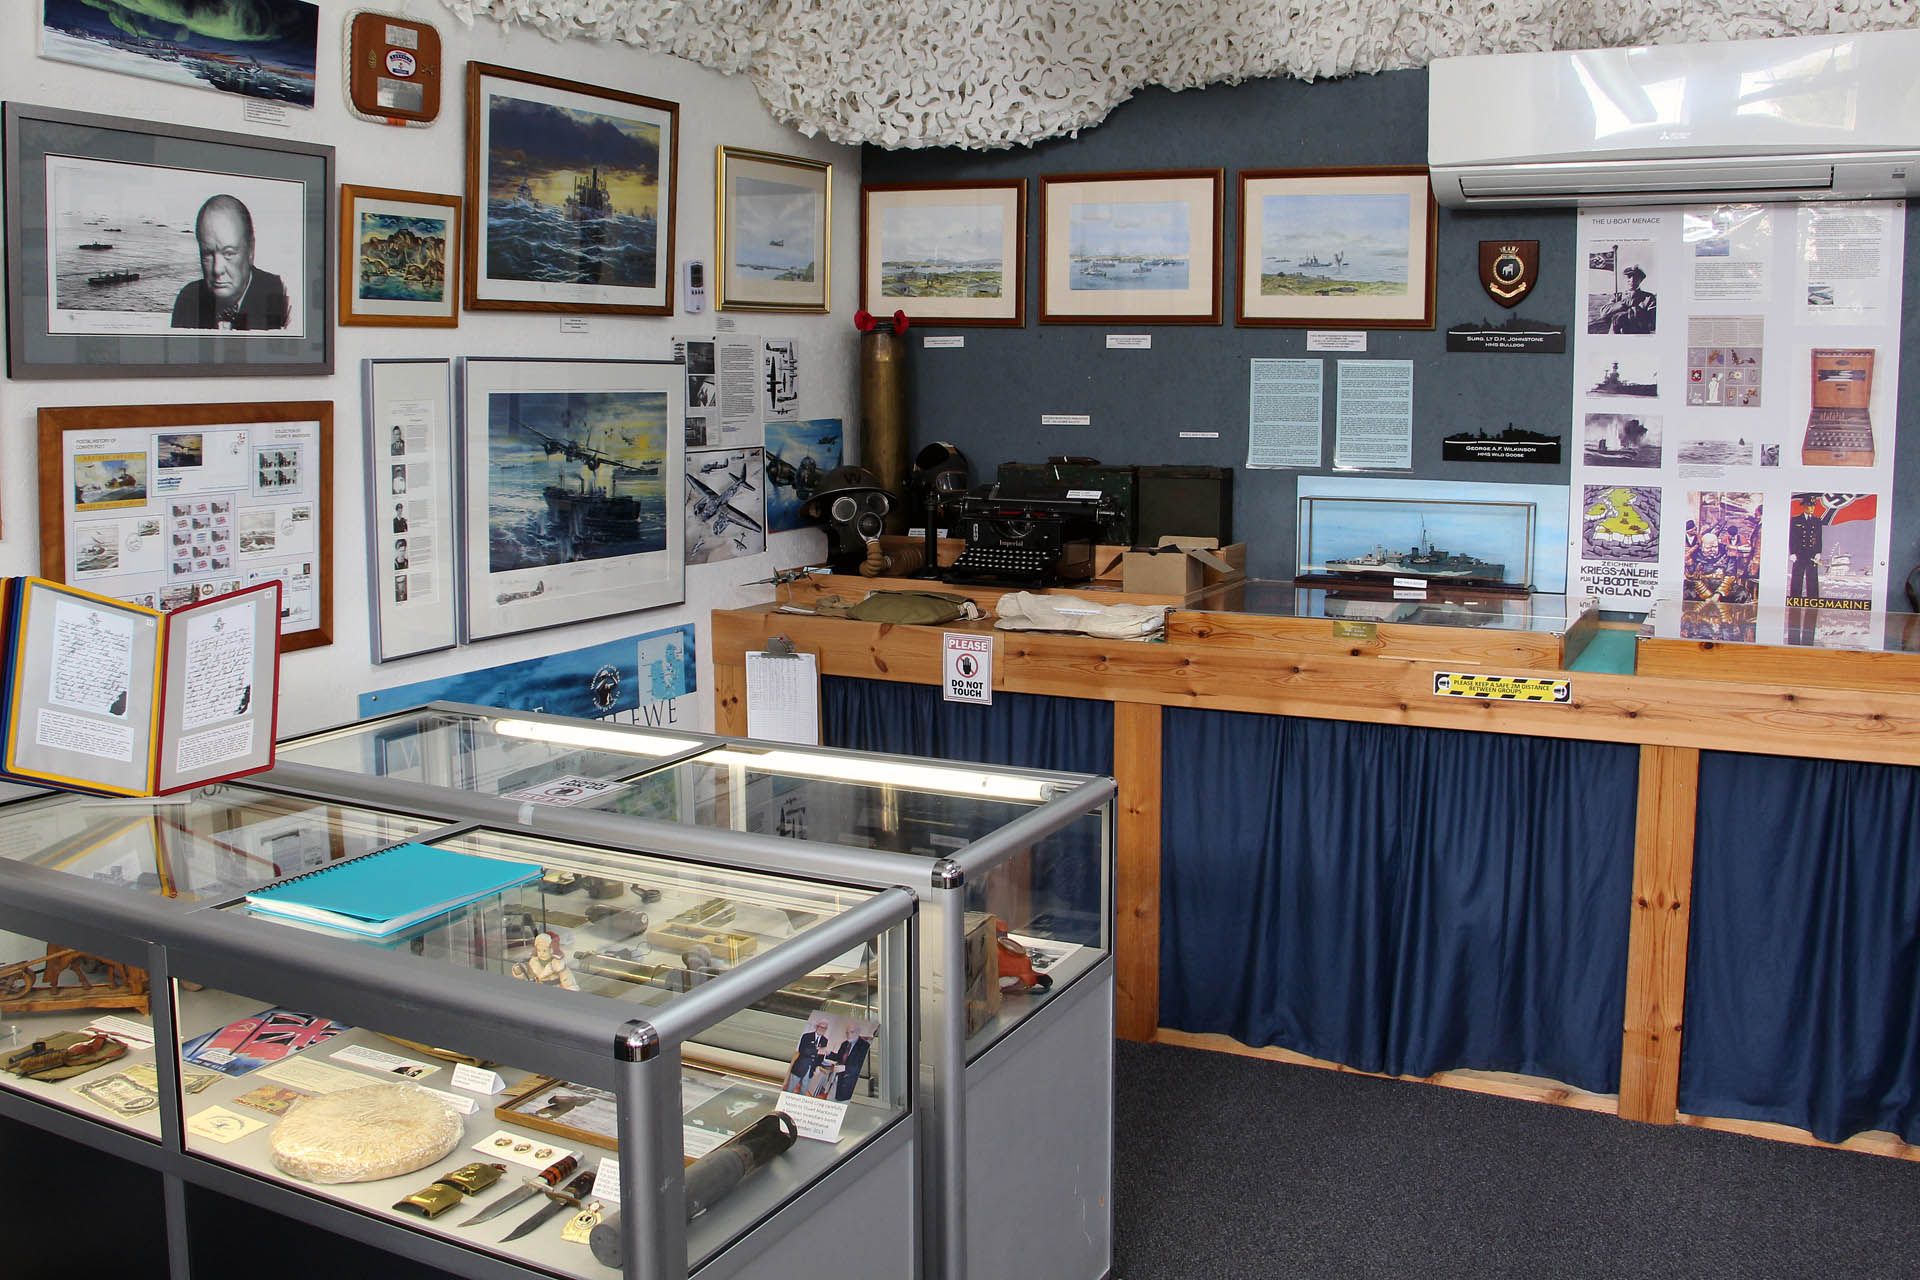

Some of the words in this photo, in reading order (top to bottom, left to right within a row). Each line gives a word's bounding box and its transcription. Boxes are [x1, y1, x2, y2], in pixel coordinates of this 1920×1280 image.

[1581, 566, 1659, 578] KRIEGS-ANLEIHE
[1592, 576, 1640, 587] U-BOOTE
[1586, 586, 1652, 598] ENGLAND
[1786, 597, 1870, 610] KRIEGSMARINE
[949, 640, 988, 651] PLEASE
[952, 680, 964, 688] DO
[966, 681, 984, 690] NOT
[953, 688, 982, 698] TOUCH
